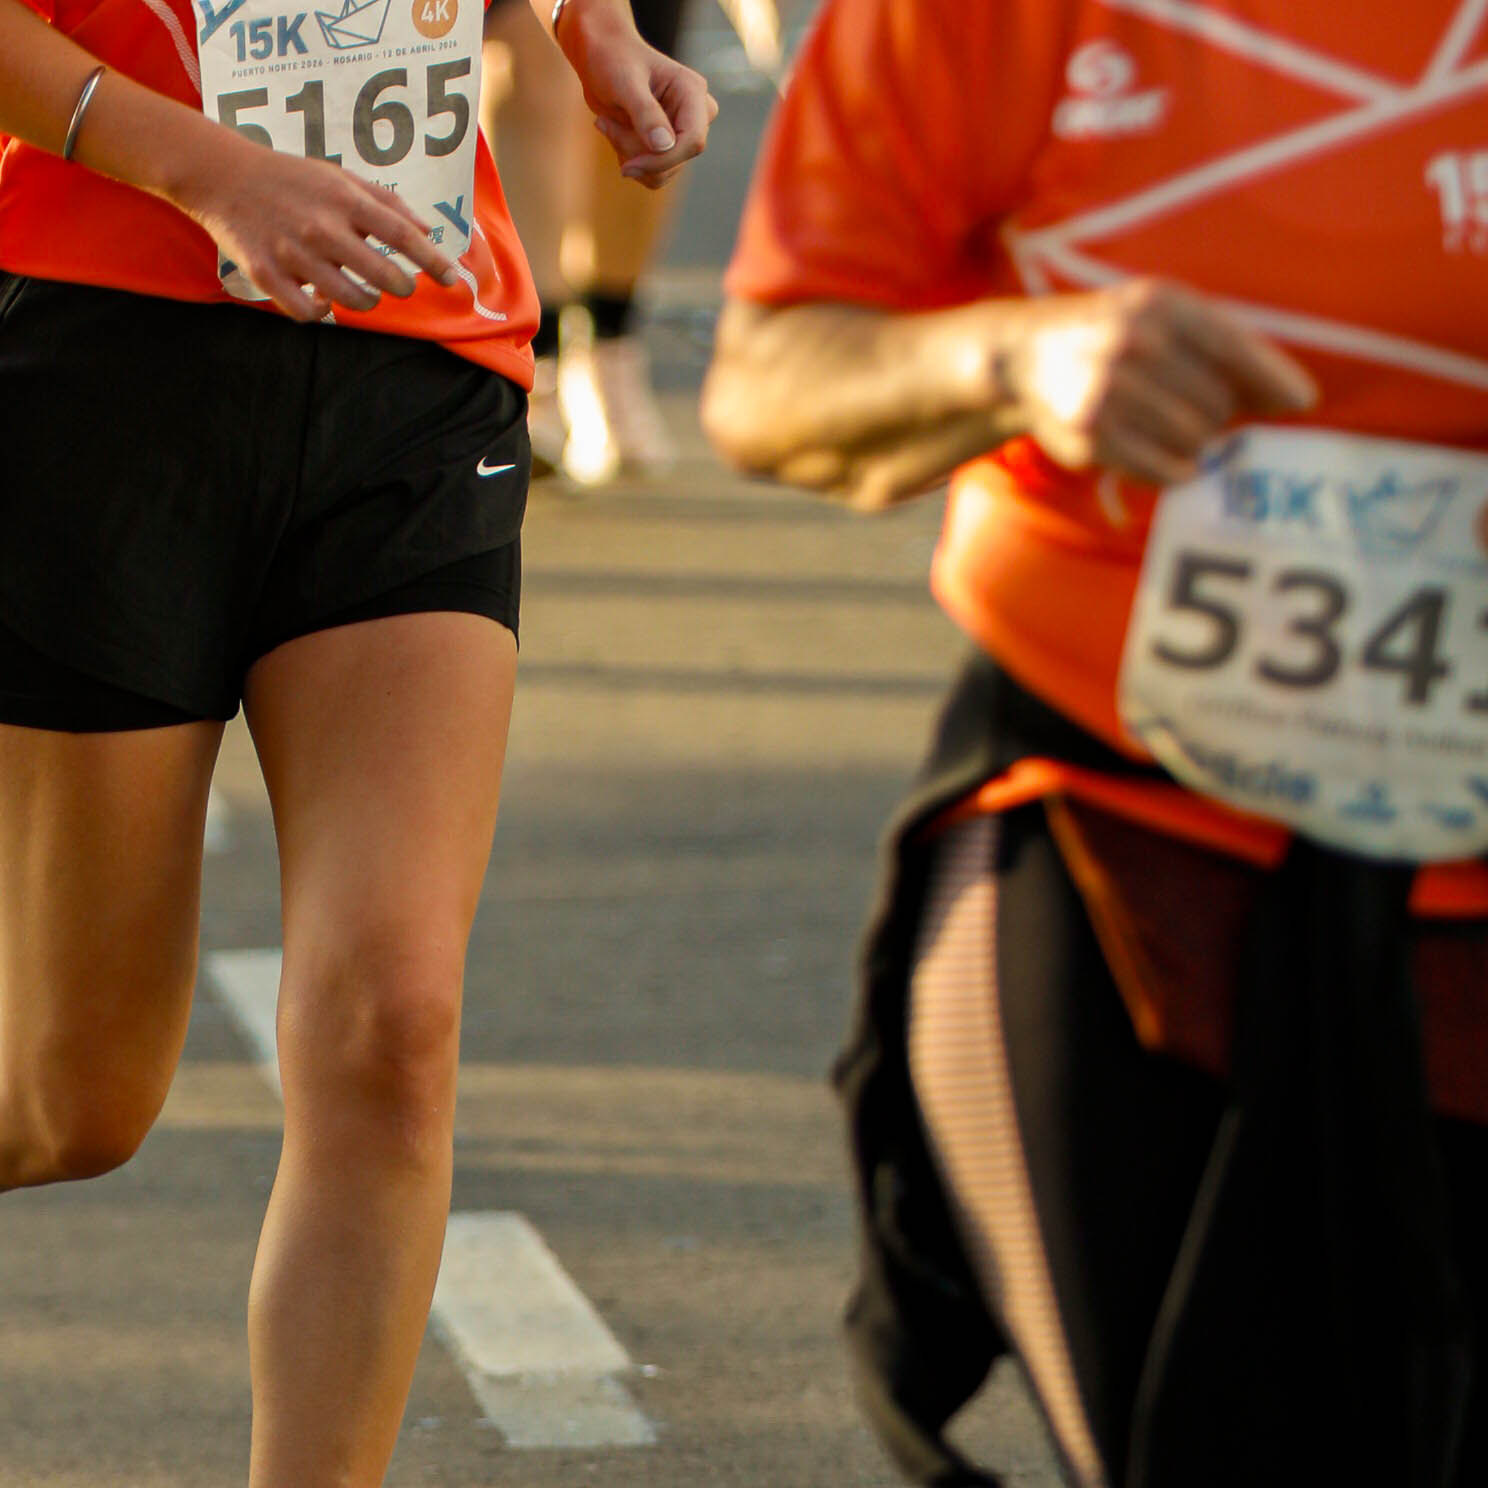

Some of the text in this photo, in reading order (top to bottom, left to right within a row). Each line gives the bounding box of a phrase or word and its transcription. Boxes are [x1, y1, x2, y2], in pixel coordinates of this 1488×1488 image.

[229, 12, 309, 62] 15K
[231, 65, 265, 78] PUERTO
[269, 62, 297, 73] NORTE
[333, 52, 372, 64] ROSARIO
[396, 47, 407, 57] DE
[410, 44, 436, 55] ABRIL
[217, 57, 472, 168] 5165
[1152, 545, 1488, 715] 534
